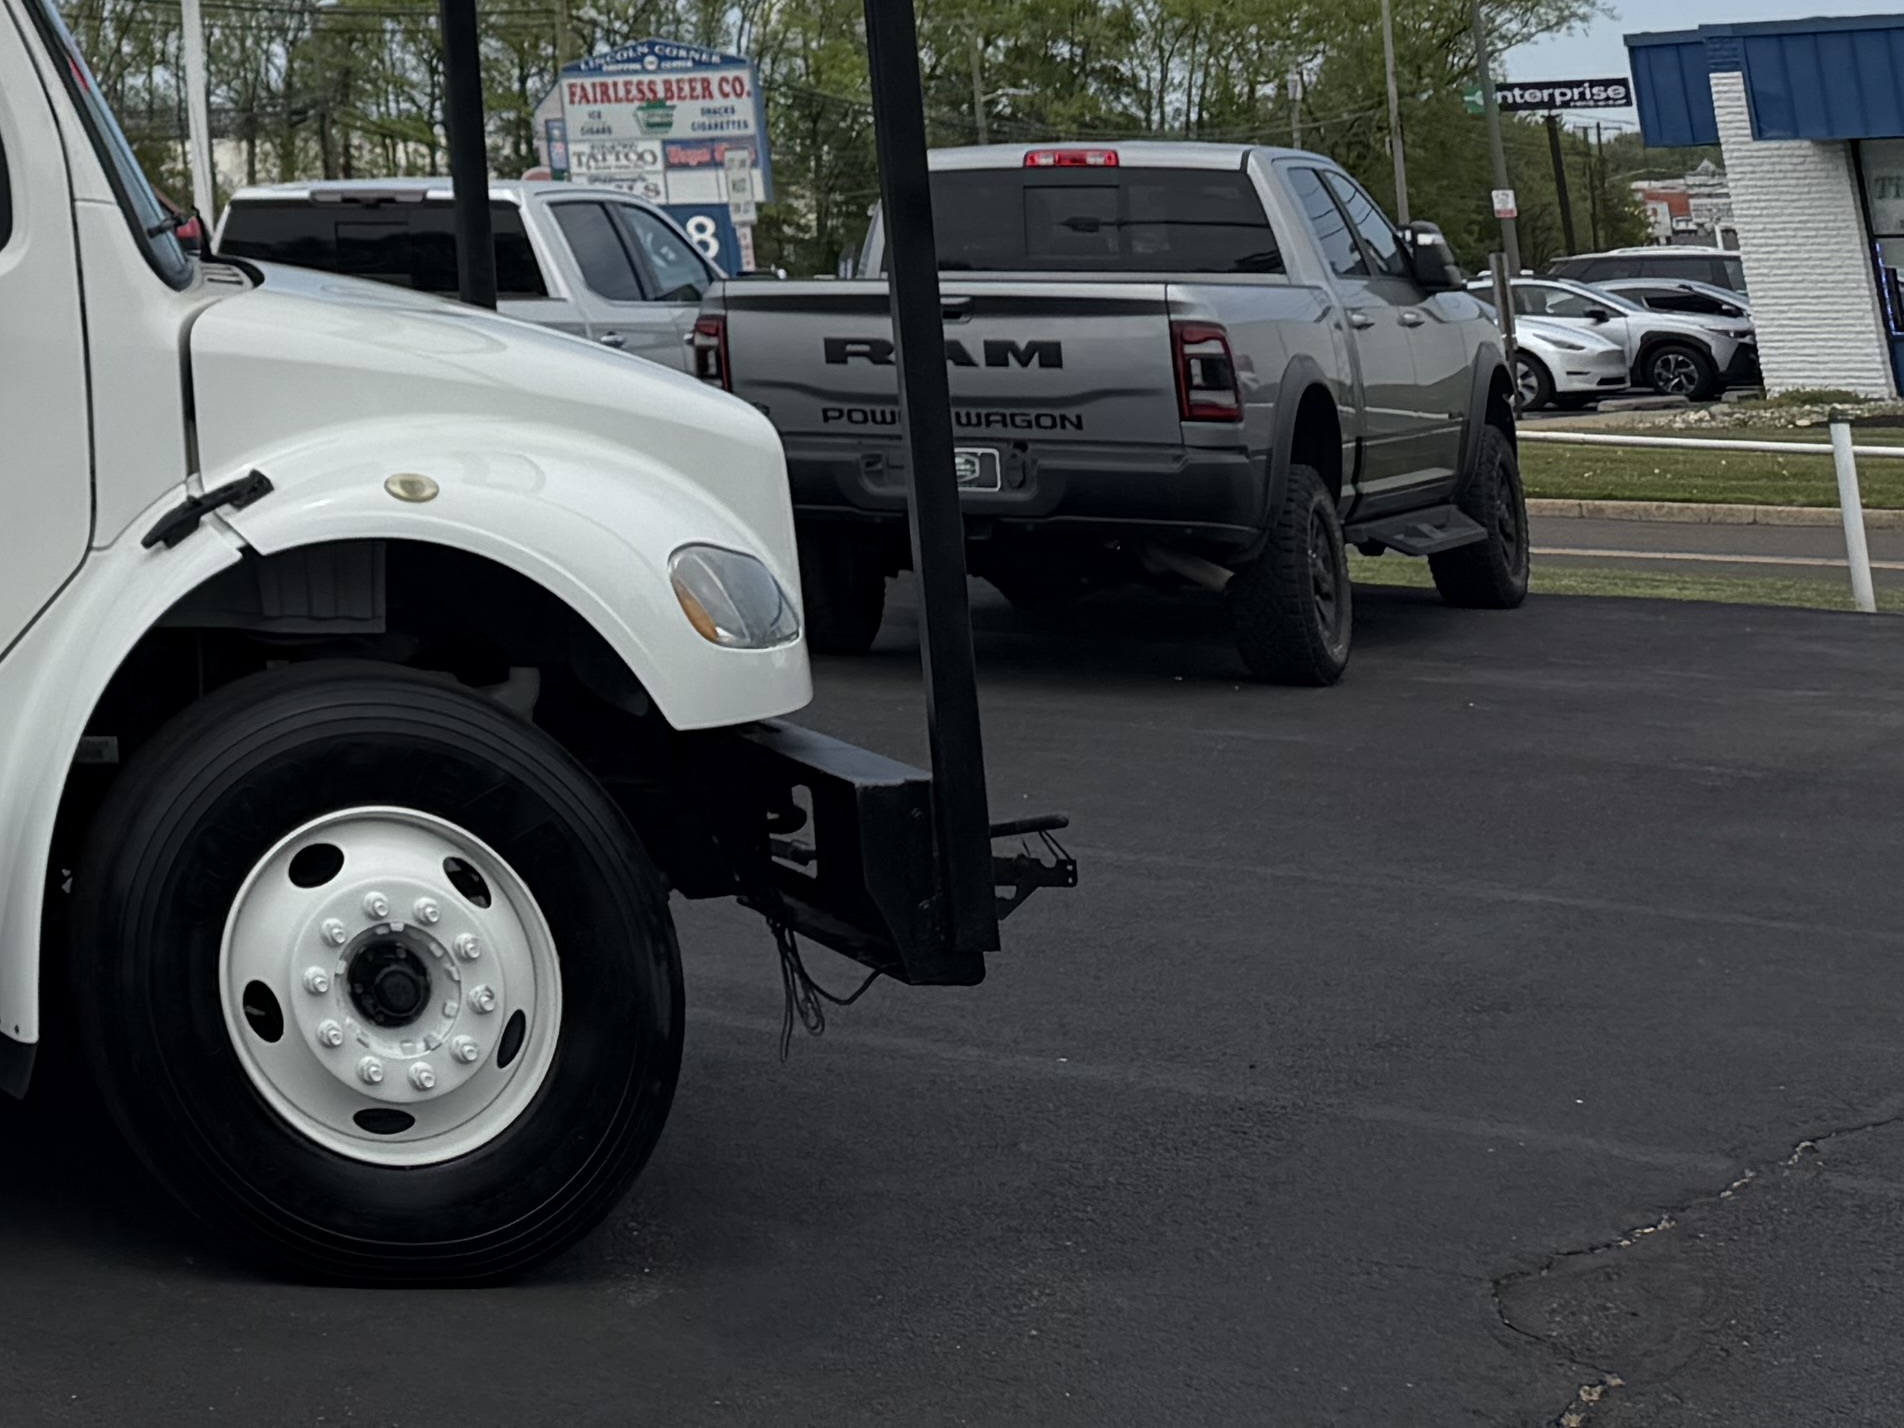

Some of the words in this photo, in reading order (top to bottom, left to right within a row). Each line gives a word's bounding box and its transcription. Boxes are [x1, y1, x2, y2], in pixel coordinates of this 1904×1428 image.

[654, 44, 722, 64] CORNER
[567, 77, 658, 105] FAIRLESS
[662, 76, 715, 102] BEER
[718, 75, 752, 100] CO.
[700, 105, 736, 117] SNACKS
[580, 126, 613, 136] CIGARS
[691, 120, 749, 132] CIGARETTES
[573, 148, 658, 170] TATTOO
[955, 411, 1084, 431] WAGON
